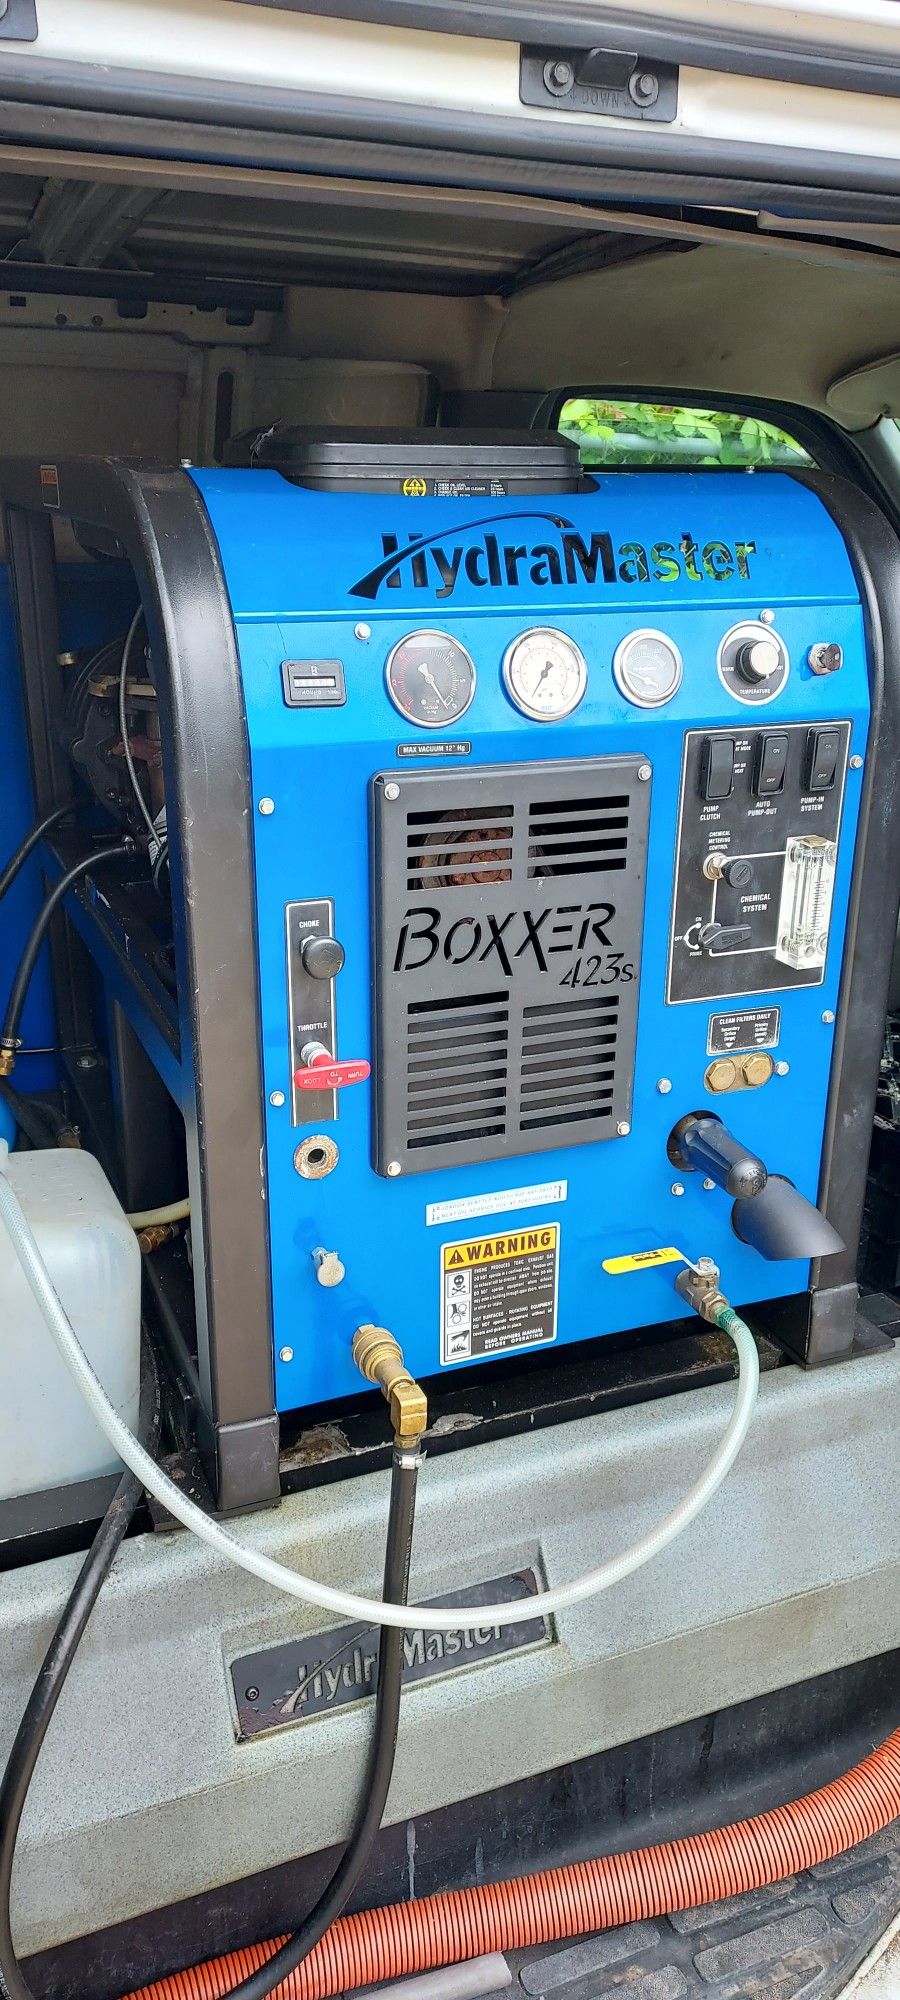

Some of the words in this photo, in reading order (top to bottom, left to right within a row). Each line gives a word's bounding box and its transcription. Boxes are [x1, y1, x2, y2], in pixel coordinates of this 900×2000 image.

[582, 91, 620, 109] DOWN
[375, 530, 757, 600] HydraMaster
[418, 745, 443, 753] VACUUM
[457, 743, 466, 752] Hg
[800, 796, 825, 804] PUMP-IN
[747, 808, 778, 816] PUMP-OUT
[800, 804, 823, 812] SYSTEM
[700, 813, 721, 821] CLUTCH
[740, 893, 771, 903] CHEMICAL
[742, 904, 768, 912] SYSTEM
[299, 919, 320, 928] CHOKE
[392, 902, 616, 977] BOXXER
[736, 1014, 756, 1023] FILTERS
[297, 1021, 328, 1032] THROTTLE
[348, 1071, 363, 1079] TURN
[466, 1231, 552, 1262] WARNING
[490, 1262, 510, 1270] PRODUCES
[483, 1311, 503, 1320] SURFACES
[531, 1300, 553, 1309] EQUIPMENT
[499, 1332, 520, 1341] OWNERS
[521, 1327, 543, 1336] MANUAL
[484, 1340, 505, 1350] BEFORE
[510, 1332, 543, 1344] OPERATING
[297, 1625, 503, 1703] HydrMaster
